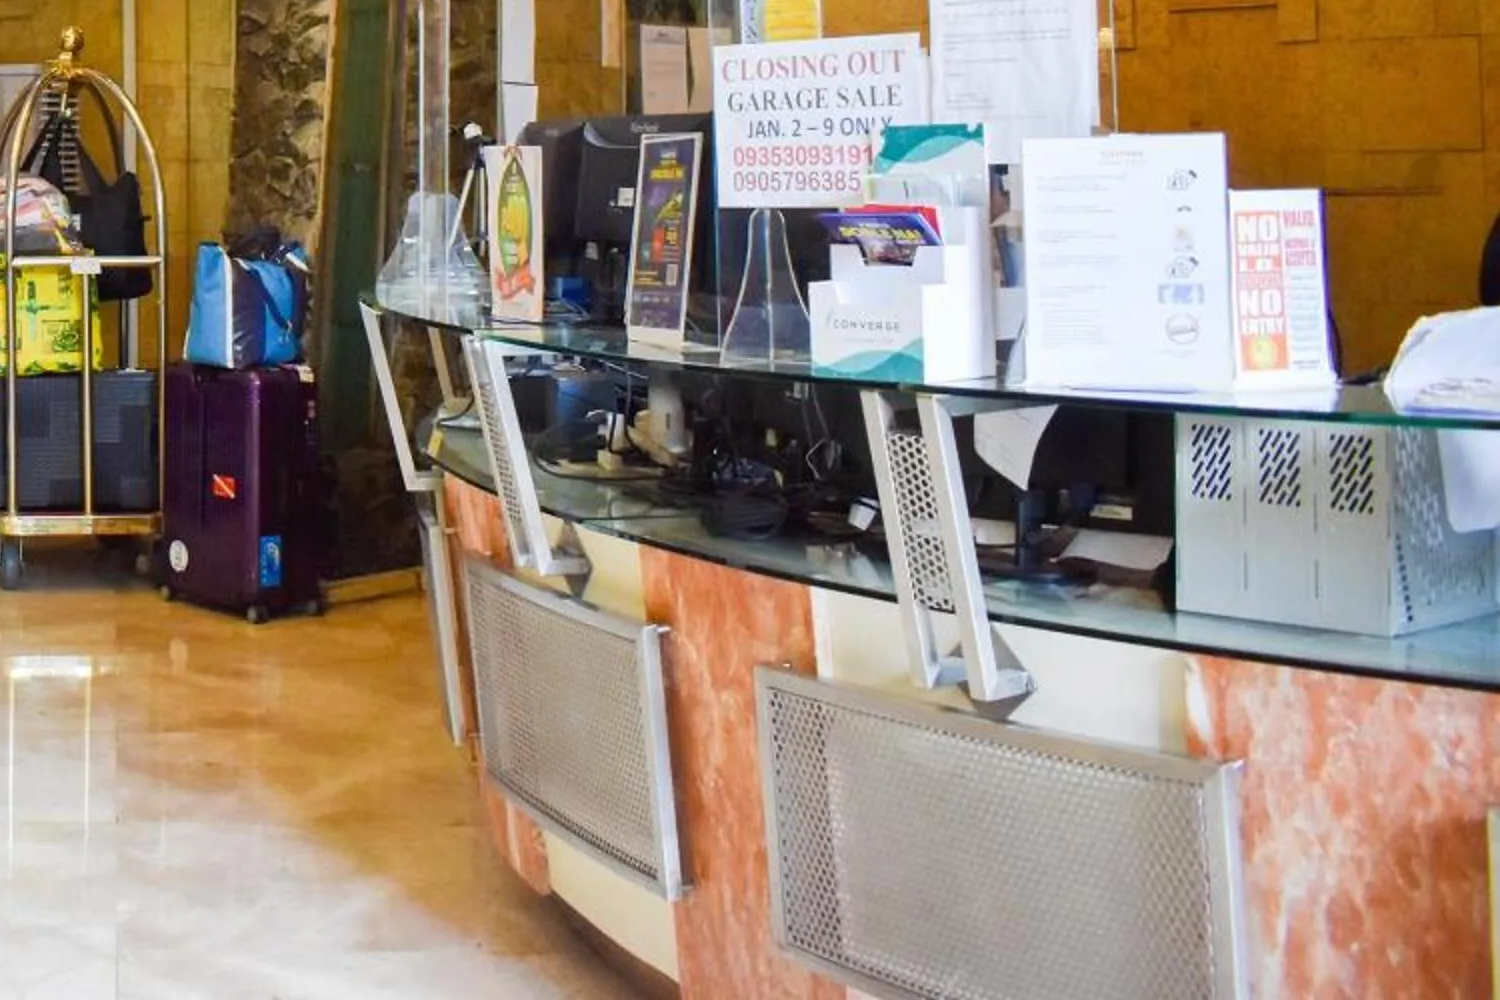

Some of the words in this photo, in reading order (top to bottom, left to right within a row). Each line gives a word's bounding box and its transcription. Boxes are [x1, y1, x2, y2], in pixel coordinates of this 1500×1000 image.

[722, 53, 839, 83] CLOSING
[847, 50, 905, 77] OUT
[727, 87, 829, 113] GARAGE
[836, 84, 902, 110] SALE
[748, 119, 786, 139] JAN.
[791, 119, 803, 137] 2
[823, 118, 835, 137] 9
[1237, 215, 1279, 242] NO
[1240, 289, 1283, 317] NO
[833, 318, 901, 331] CONVERGE
[1242, 318, 1285, 335] ENTRY
